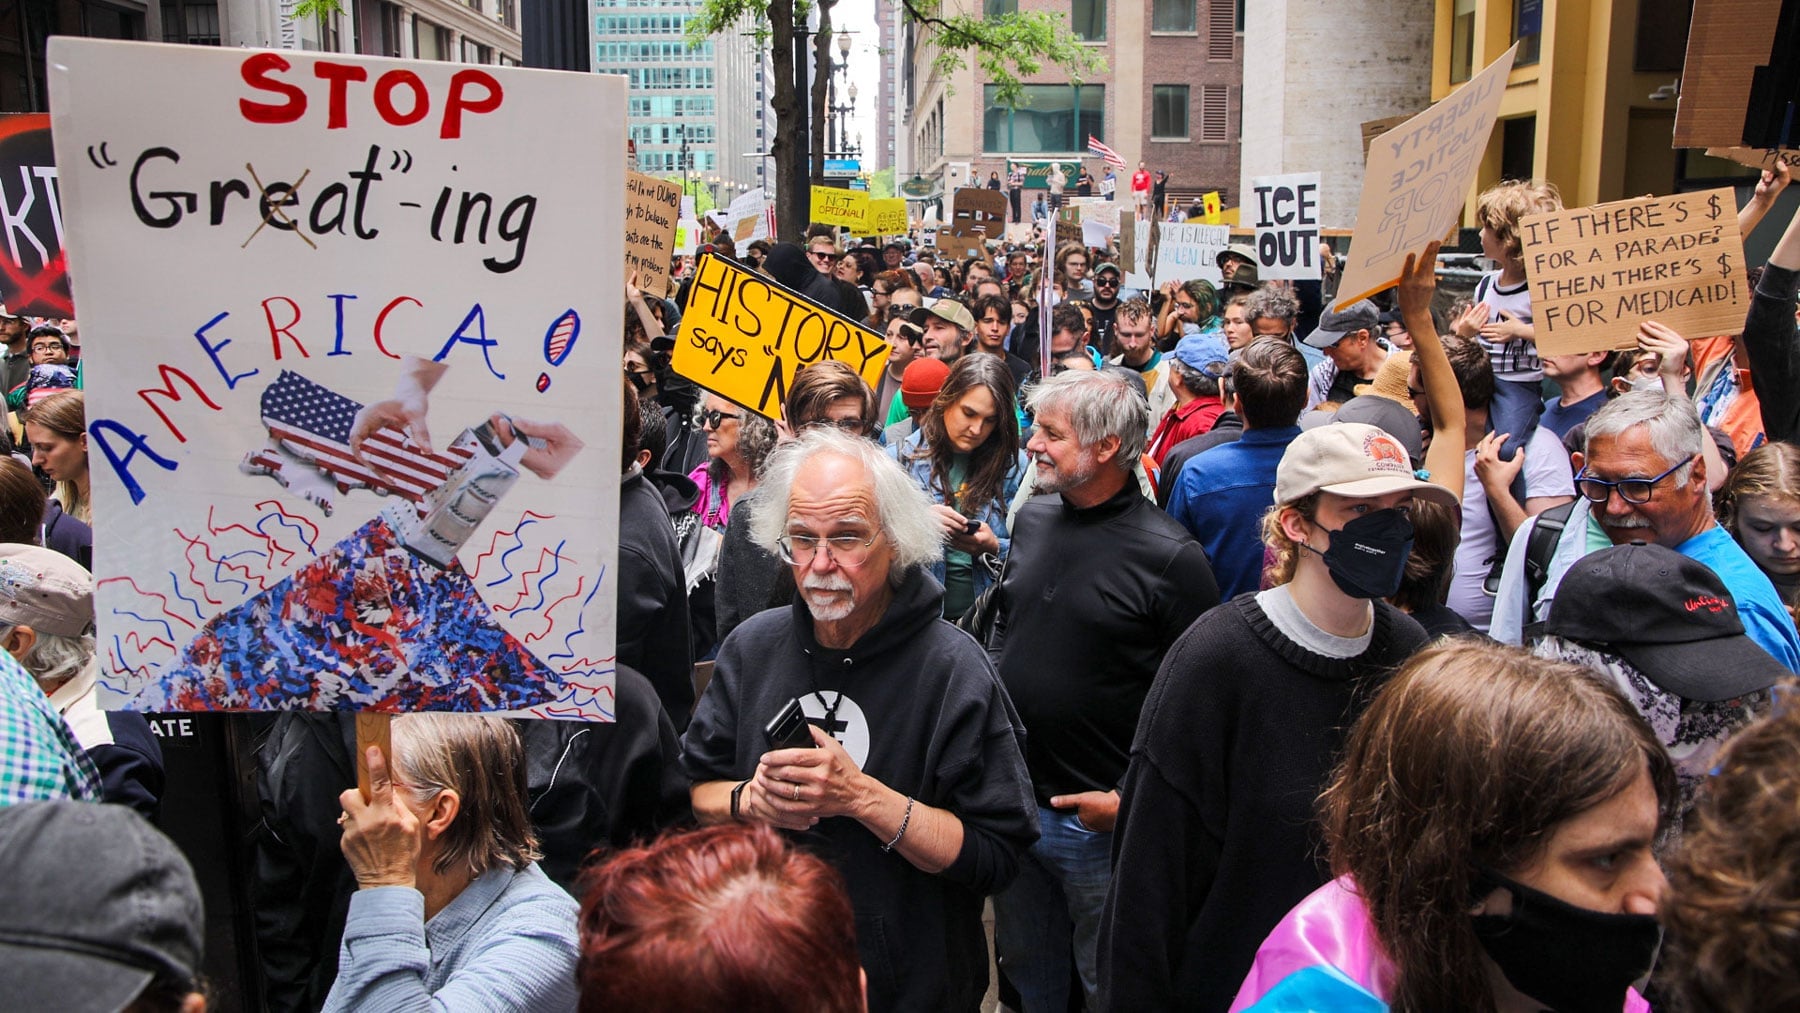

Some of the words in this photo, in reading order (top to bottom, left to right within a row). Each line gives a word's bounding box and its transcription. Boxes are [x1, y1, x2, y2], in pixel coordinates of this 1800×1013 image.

[239, 53, 503, 139] STOP
[635, 202, 644, 219] to
[644, 204, 669, 230] believe
[656, 184, 678, 208] DUMB
[818, 205, 865, 220] OPTIONAL!
[825, 195, 855, 208] NOT
[1253, 183, 1317, 228] ICE
[1181, 226, 1194, 244] IS
[1194, 227, 1228, 248] ILLEGAL
[1524, 218, 1560, 247] IF
[1571, 201, 1689, 238] THERE'S
[1704, 194, 1722, 221] $
[651, 234, 664, 250] the
[1201, 248, 1217, 267] LA
[1259, 229, 1318, 268] OUT
[1534, 249, 1578, 274] FOR
[1588, 248, 1602, 263] A
[1615, 225, 1723, 262] PARADE?
[640, 255, 664, 275] problems
[1537, 274, 1605, 300] THEN
[1612, 258, 1702, 287] THERE'S
[1717, 253, 1732, 279] $
[690, 255, 888, 375] HISTORY
[1545, 300, 1608, 332] FOR
[1616, 280, 1737, 320] MEDICAID!
[690, 327, 748, 375] says
[89, 294, 581, 506] AMERICA!
